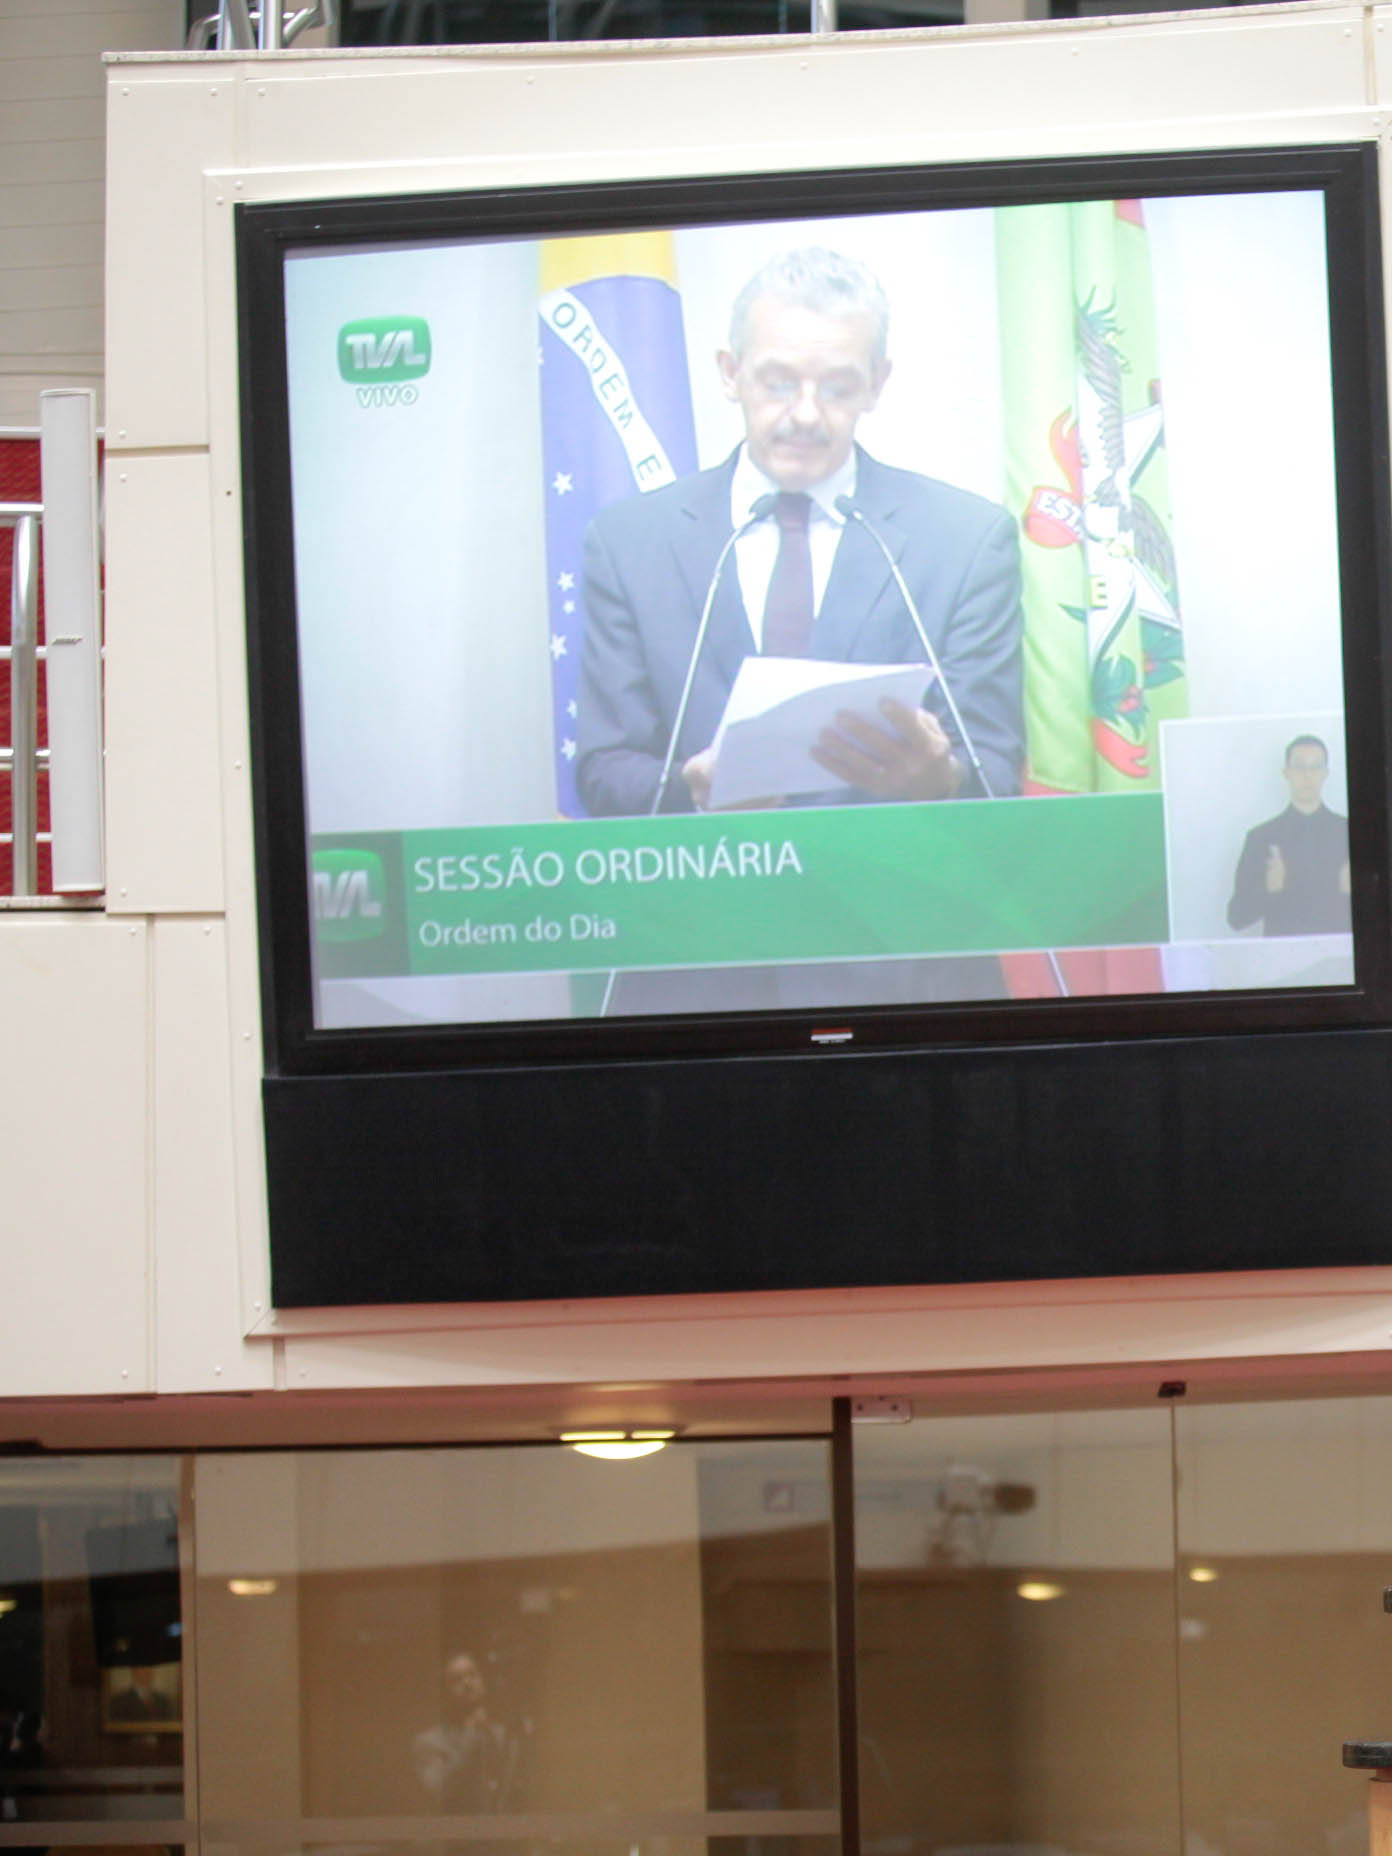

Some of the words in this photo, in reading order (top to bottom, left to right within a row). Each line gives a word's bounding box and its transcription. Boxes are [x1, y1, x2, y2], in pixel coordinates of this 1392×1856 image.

[356, 386, 419, 408] VIVO
[636, 453, 663, 481] E
[414, 848, 565, 893] SESSÃO
[575, 836, 803, 886] ORDINÁRIA
[418, 919, 517, 947] Ordem
[525, 915, 562, 942] do
[570, 914, 617, 941] Dia
